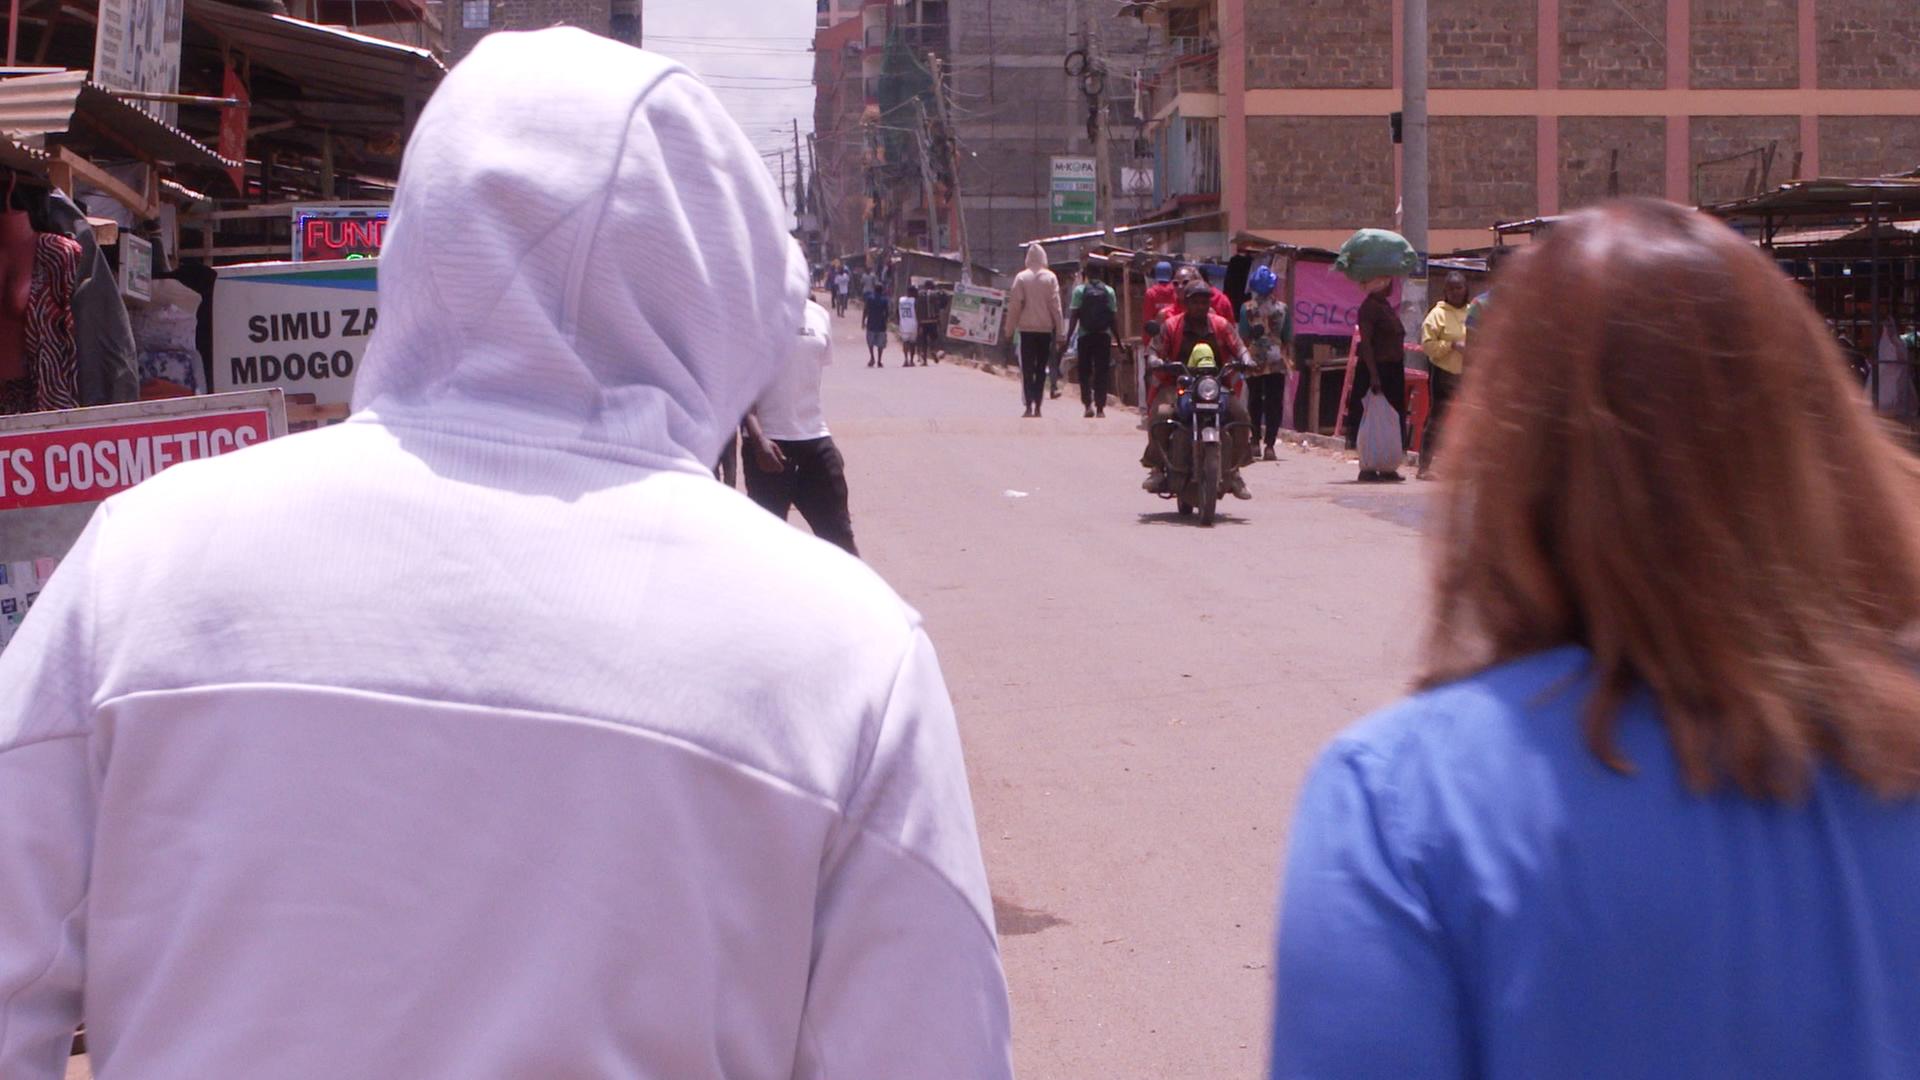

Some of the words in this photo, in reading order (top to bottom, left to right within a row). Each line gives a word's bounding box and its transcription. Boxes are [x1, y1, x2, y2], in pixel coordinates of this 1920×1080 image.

[1055, 161, 1094, 172] M-KOPA
[248, 310, 331, 343] SIMU
[341, 307, 378, 337] ZA
[230, 350, 354, 385] MDOGO
